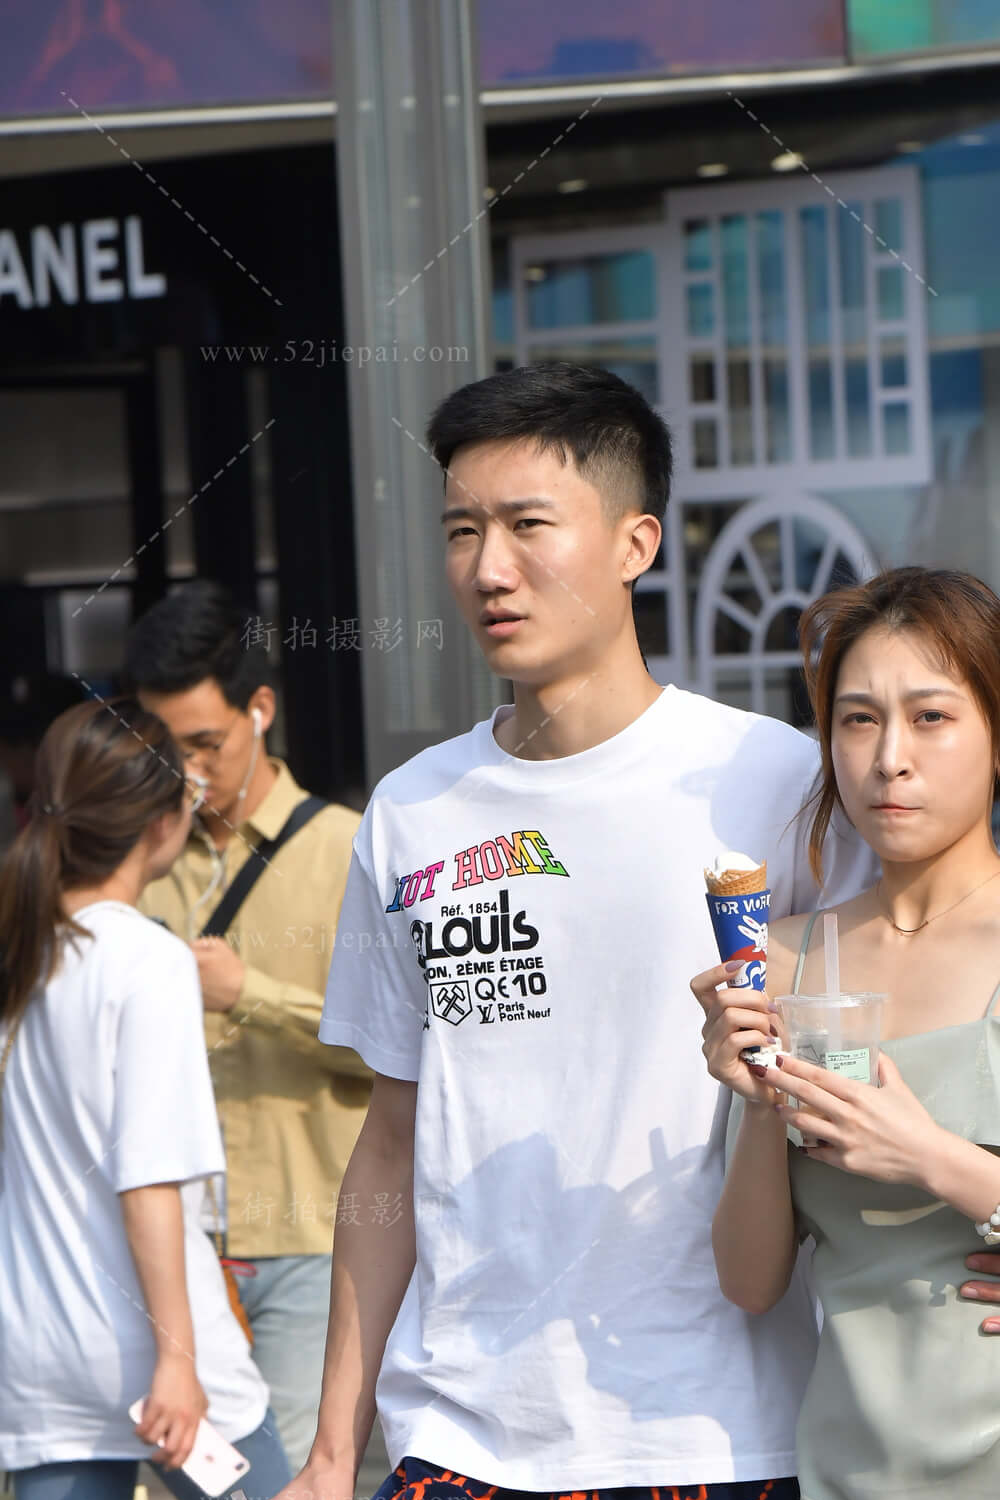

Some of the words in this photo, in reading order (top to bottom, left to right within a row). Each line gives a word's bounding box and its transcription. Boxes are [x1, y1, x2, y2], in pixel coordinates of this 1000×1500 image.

[451, 830, 571, 891] HOME
[441, 903, 464, 918] Réf.
[468, 901, 498, 915] 1854
[714, 901, 740, 915] FOR
[456, 960, 495, 976] 2ÈME
[500, 956, 545, 973] ÉTAGE
[498, 1001, 525, 1012] Paris
[499, 1010, 527, 1023] Pont
[527, 1007, 552, 1020] Neuf
